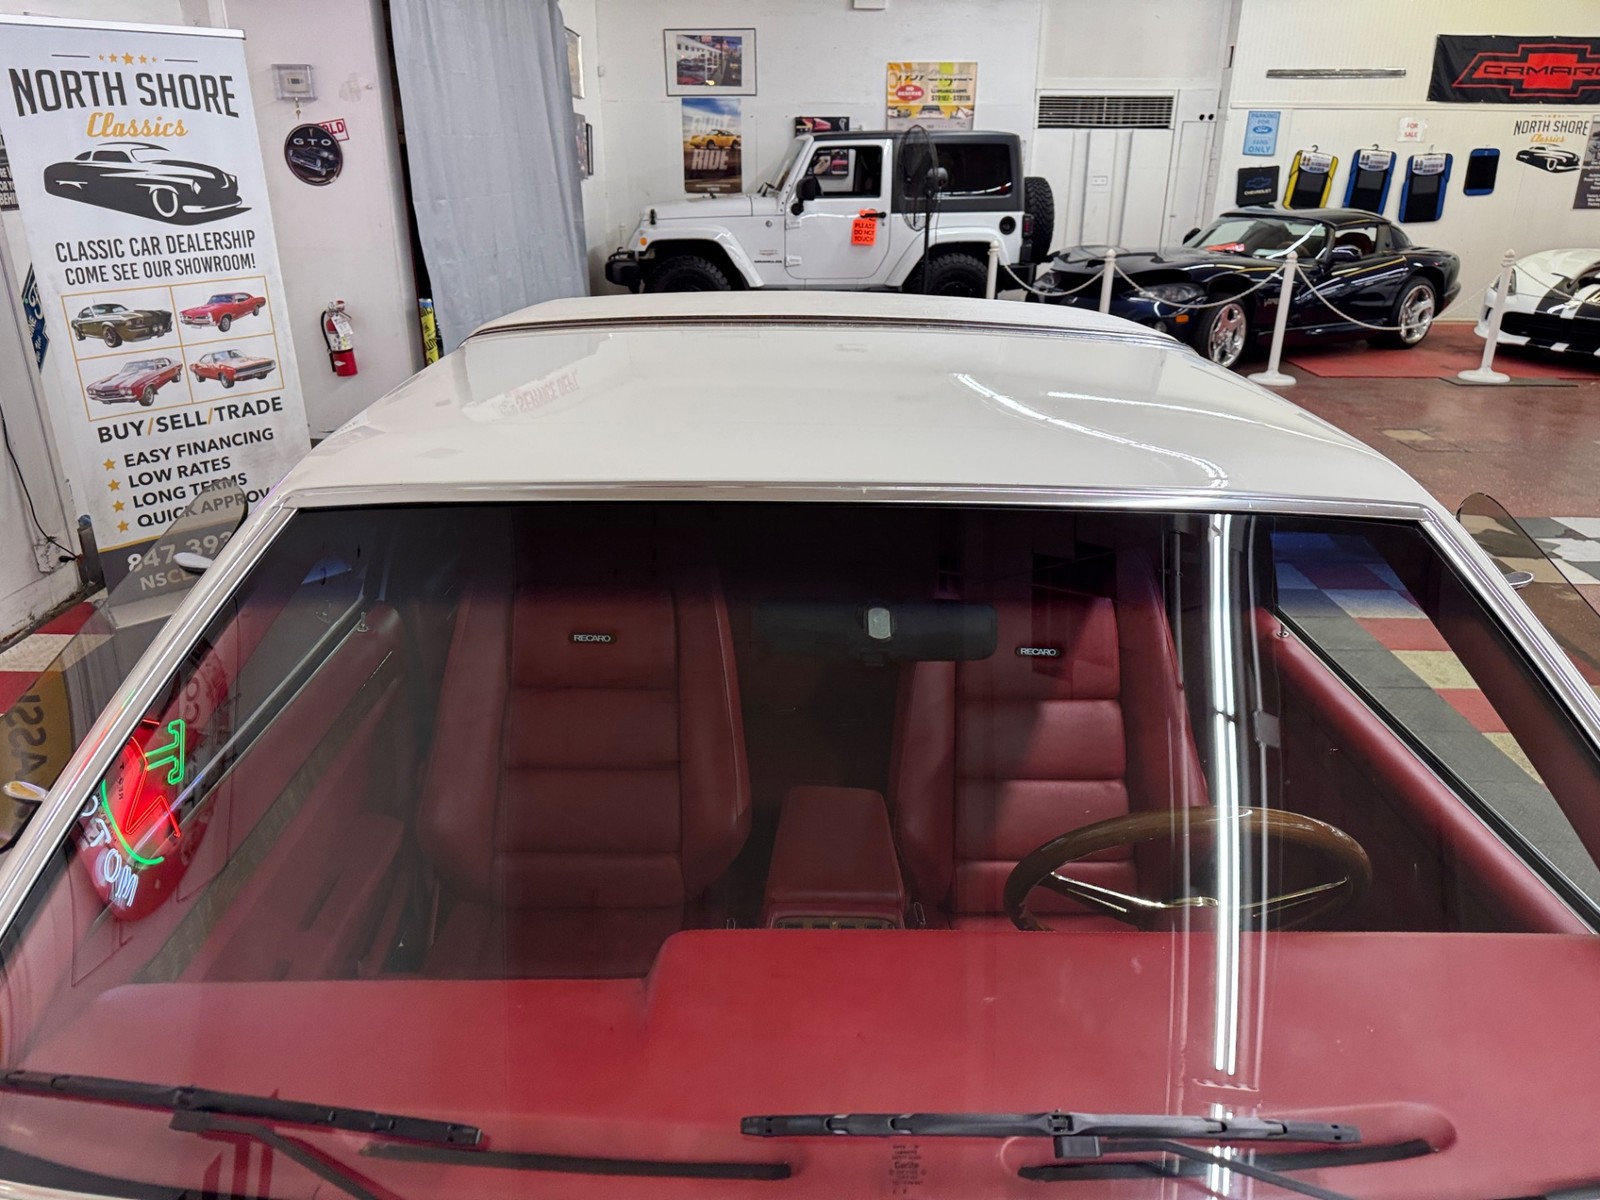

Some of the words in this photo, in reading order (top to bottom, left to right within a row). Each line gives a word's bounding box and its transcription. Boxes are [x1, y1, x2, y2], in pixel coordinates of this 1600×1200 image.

[9, 68, 127, 117] NORTH
[135, 73, 239, 118] SHORE
[86, 112, 189, 138] Classics
[1513, 120, 1550, 136] NORTH
[1553, 120, 1589, 136] SHORE
[293, 137, 332, 146] GTO
[1530, 133, 1565, 143] Classics
[691, 149, 729, 170] RIDE
[1244, 188, 1272, 196] CHEVROLET
[55, 238, 125, 263] CLASSIC
[129, 236, 163, 257] CAR
[165, 229, 256, 255] DEALERSHIP
[65, 265, 110, 286] COME
[113, 262, 140, 281] SEE
[143, 260, 173, 279] OUR
[176, 253, 256, 277] SHOWROOM!
[124, 446, 172, 468] EASY
[177, 427, 274, 458] FINANCING
[128, 467, 172, 488] LOW
[177, 456, 231, 480] RATES
[133, 486, 187, 508] LONG
[189, 472, 247, 495] TERMS
[137, 506, 196, 528] QUICK
[127, 544, 176, 572] 847
[573, 634, 612, 642] RECARO
[1020, 647, 1057, 656] RECARO
